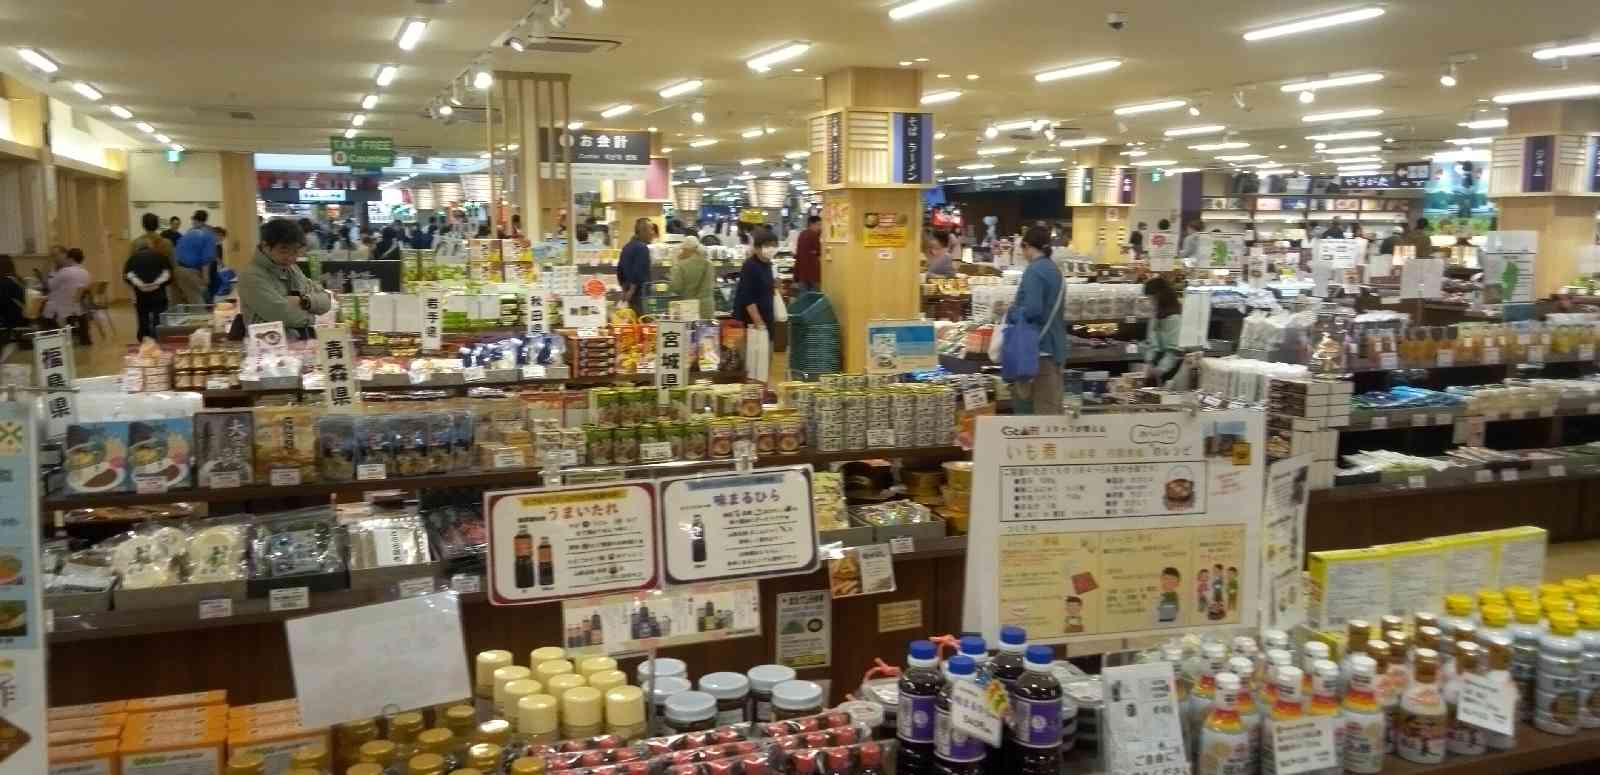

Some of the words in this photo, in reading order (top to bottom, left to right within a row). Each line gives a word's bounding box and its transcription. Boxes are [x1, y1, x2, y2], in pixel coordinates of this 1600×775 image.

[580, 134, 628, 149] お会計
[907, 143, 919, 181] ラーメン
[324, 340, 352, 407] 青森県
[661, 330, 681, 389] 宮城県
[41, 347, 71, 420] 福島県
[547, 503, 620, 521] うまいたれ
[713, 488, 781, 507] 味まるひら
